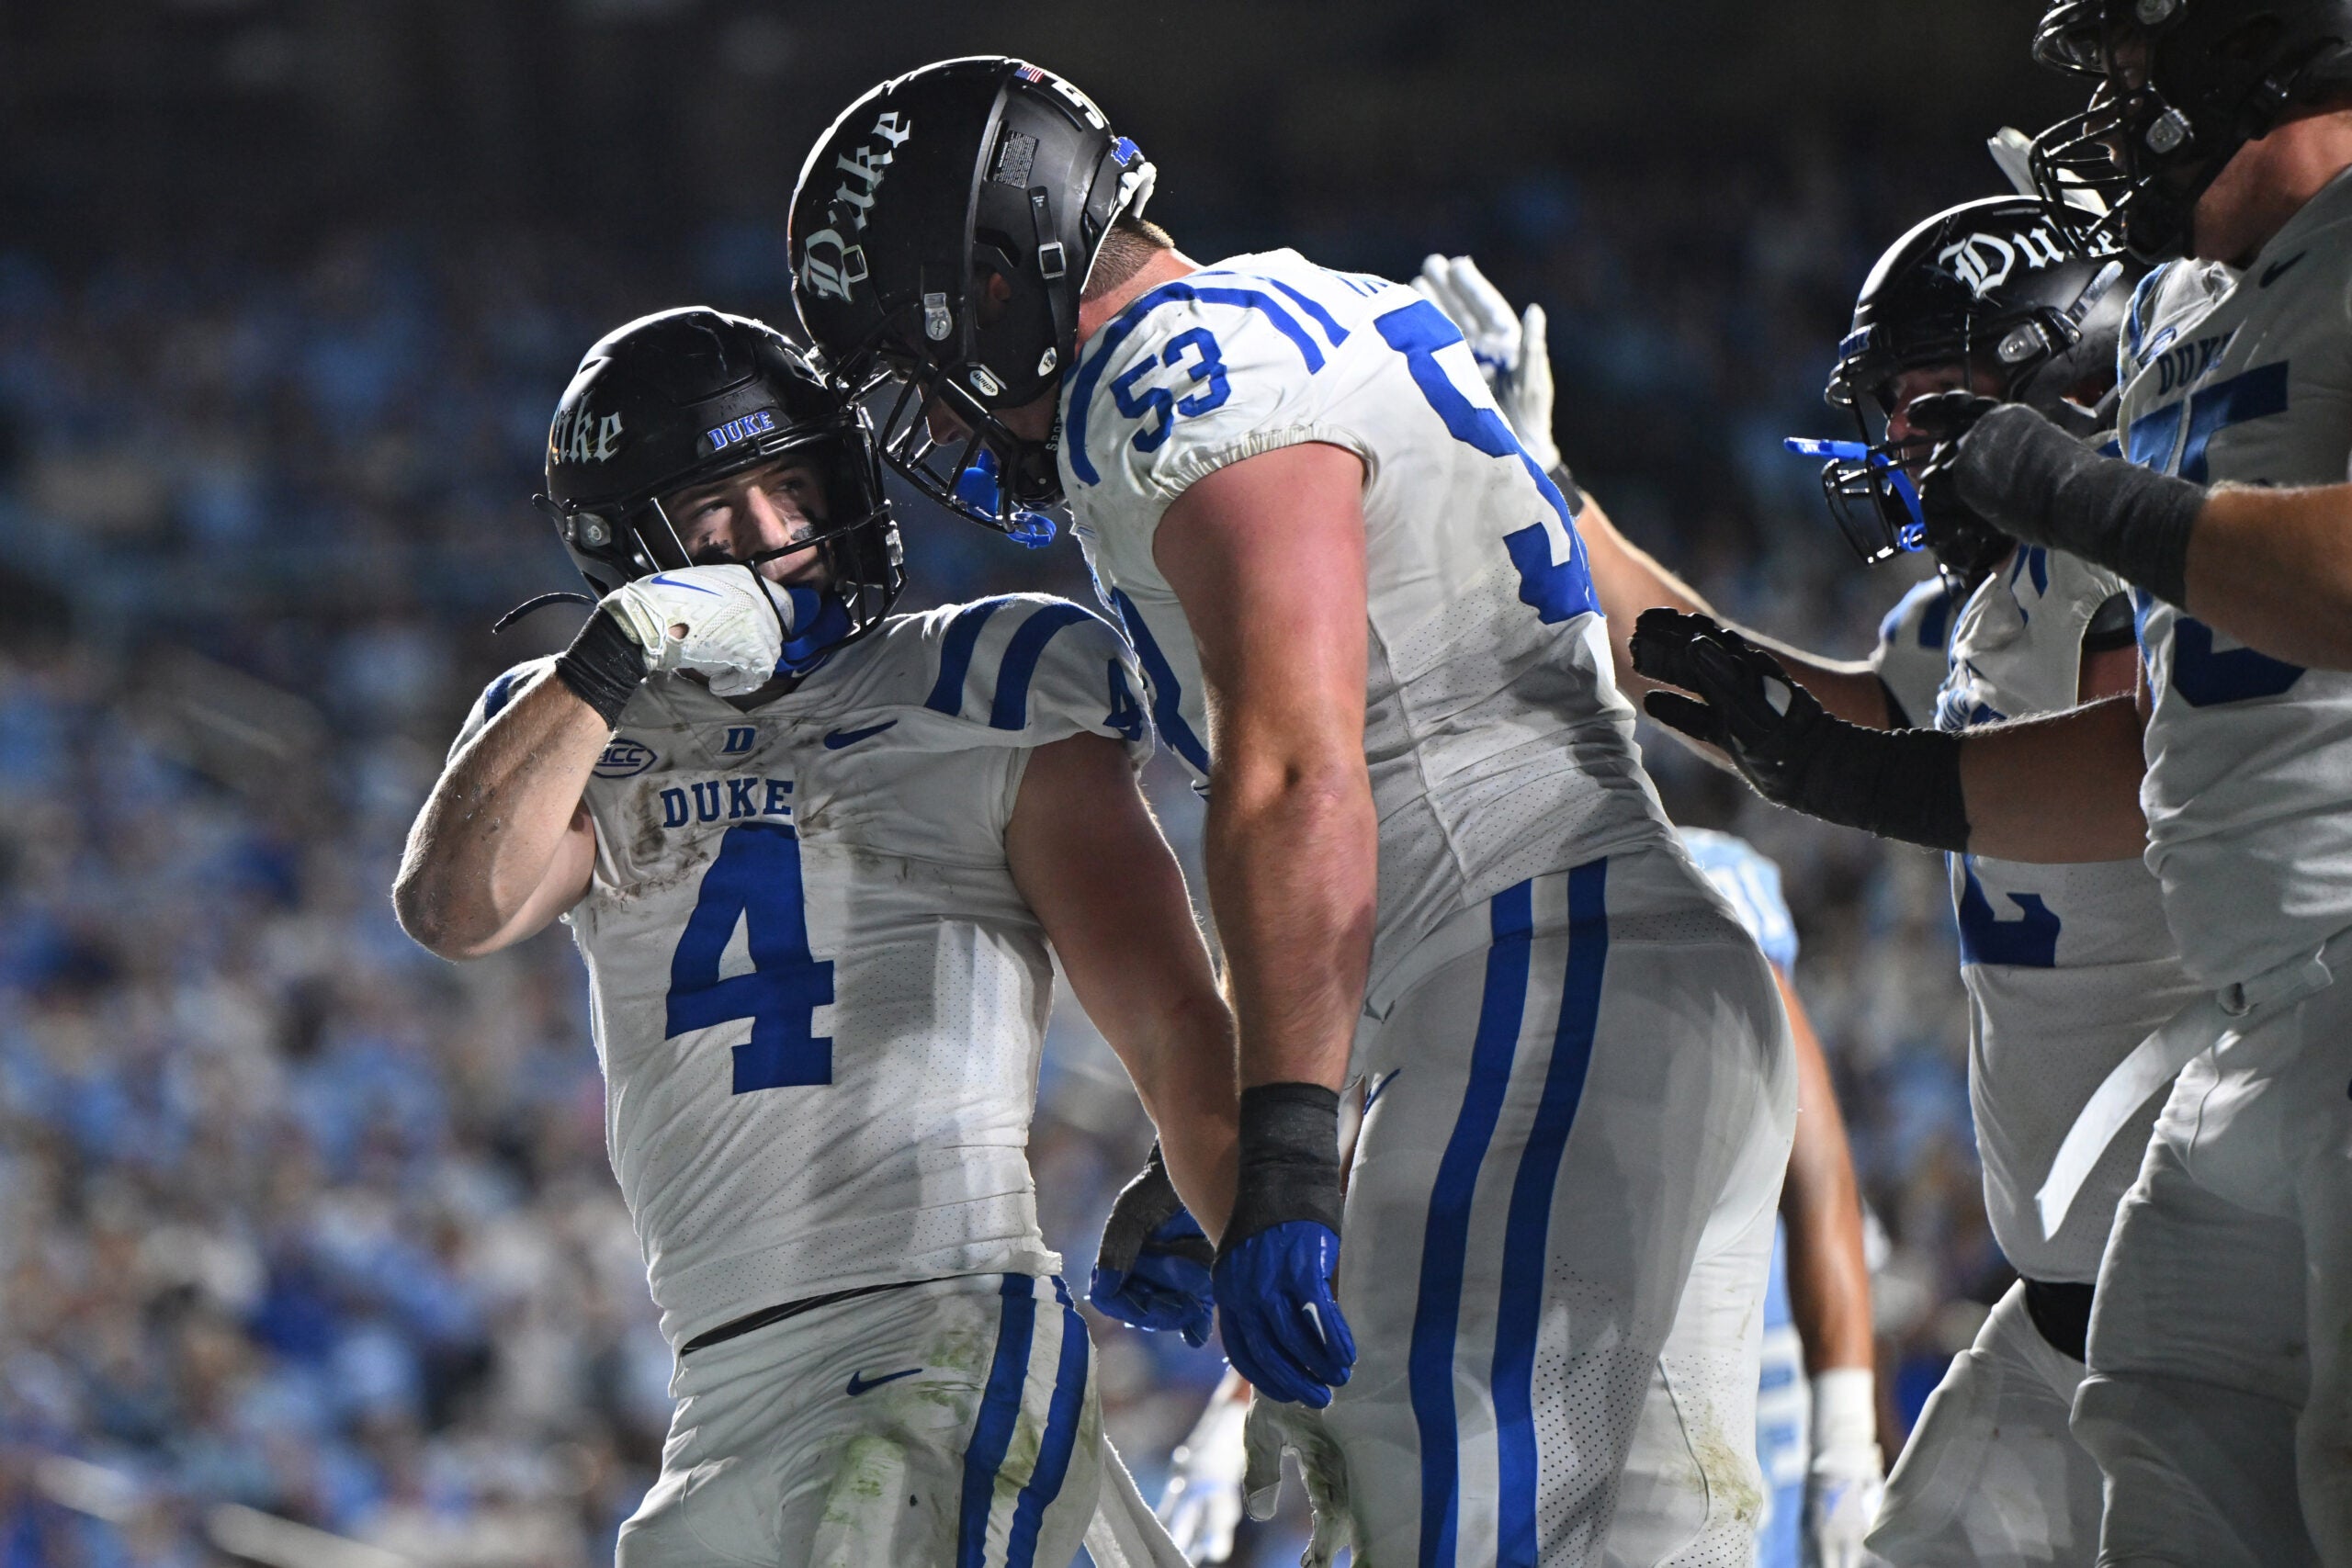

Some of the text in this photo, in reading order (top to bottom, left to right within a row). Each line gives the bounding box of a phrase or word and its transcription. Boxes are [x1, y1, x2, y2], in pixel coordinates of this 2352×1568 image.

[801, 110, 912, 304] Duke
[551, 389, 625, 464] uke
[707, 410, 776, 451] DUKE
[1109, 326, 1232, 454] 53
[1374, 299, 1606, 626] 5
[721, 727, 758, 754] D
[1102, 657, 1143, 742] 4
[659, 776, 794, 829] DUKE
[664, 820, 835, 1096] 4
